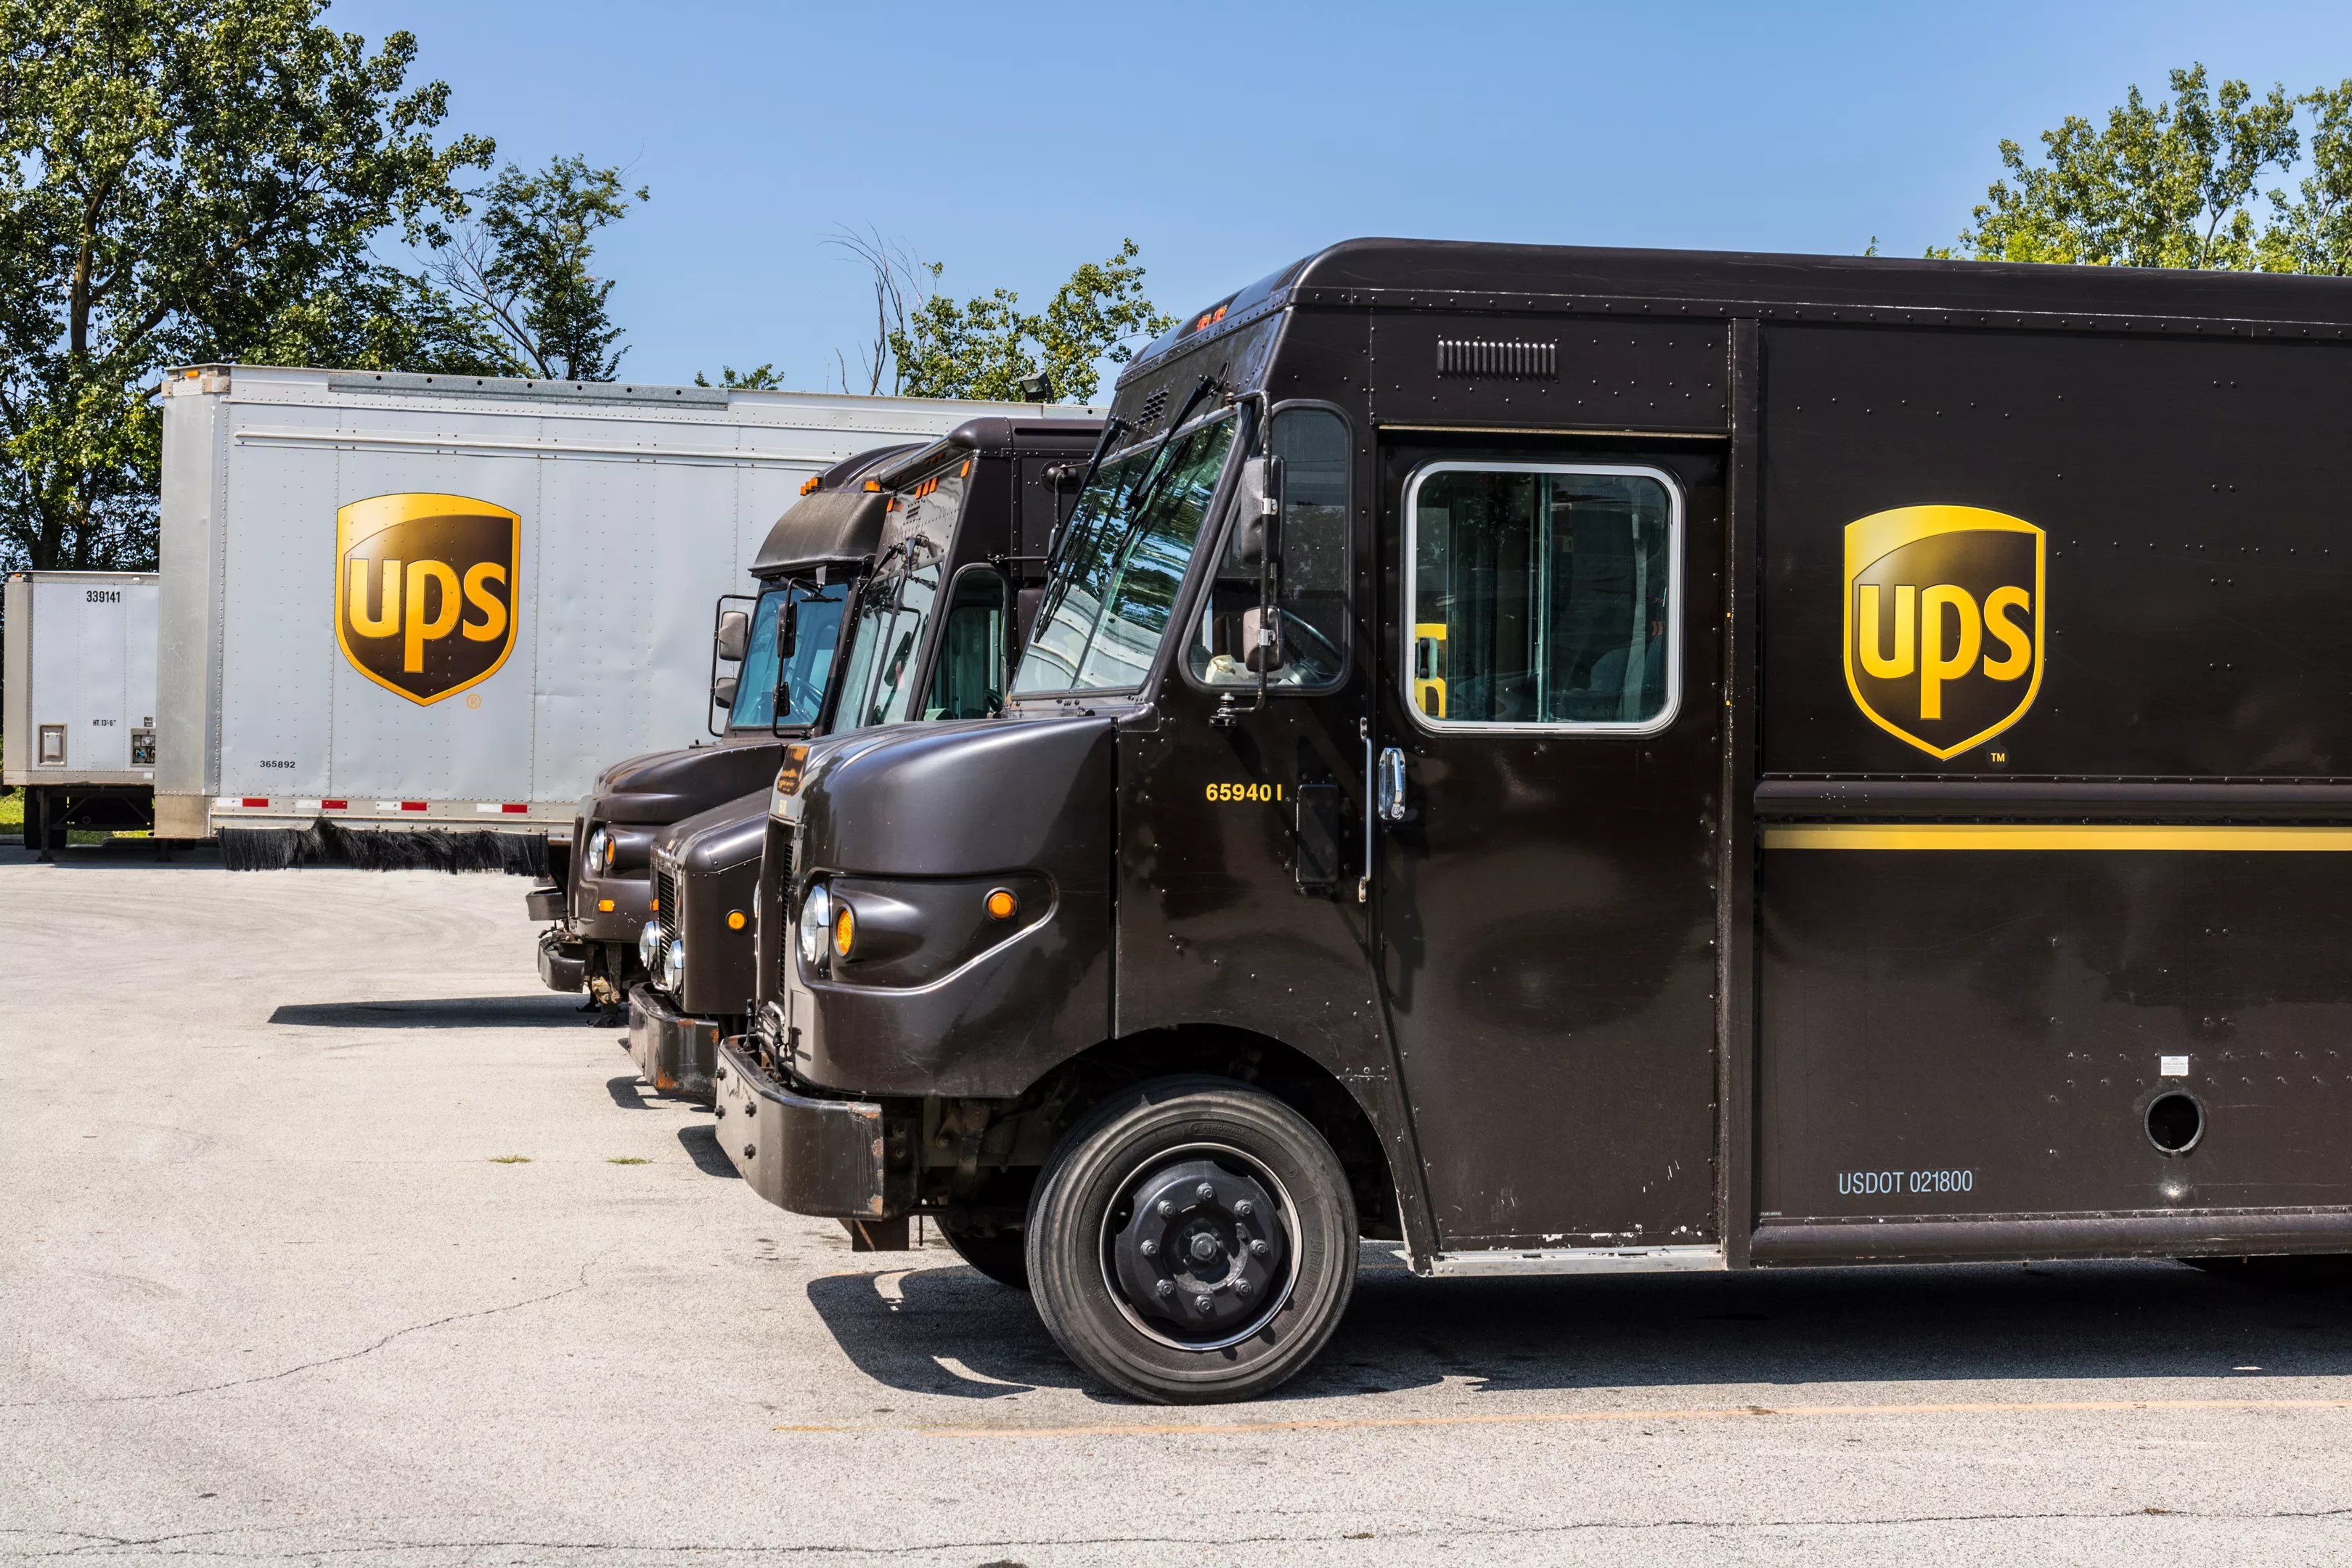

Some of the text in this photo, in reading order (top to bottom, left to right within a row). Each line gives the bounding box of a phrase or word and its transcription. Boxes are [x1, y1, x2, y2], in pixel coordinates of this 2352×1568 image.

[86, 590, 121, 603] 339141
[349, 558, 507, 673] ups
[1859, 584, 2032, 720] ups
[259, 760, 295, 769] 365892
[1206, 783, 1282, 801] 659401
[1839, 1169, 1973, 1195] USDOT 021800
[1275, 1238, 1325, 1336] BRIDGESTON
